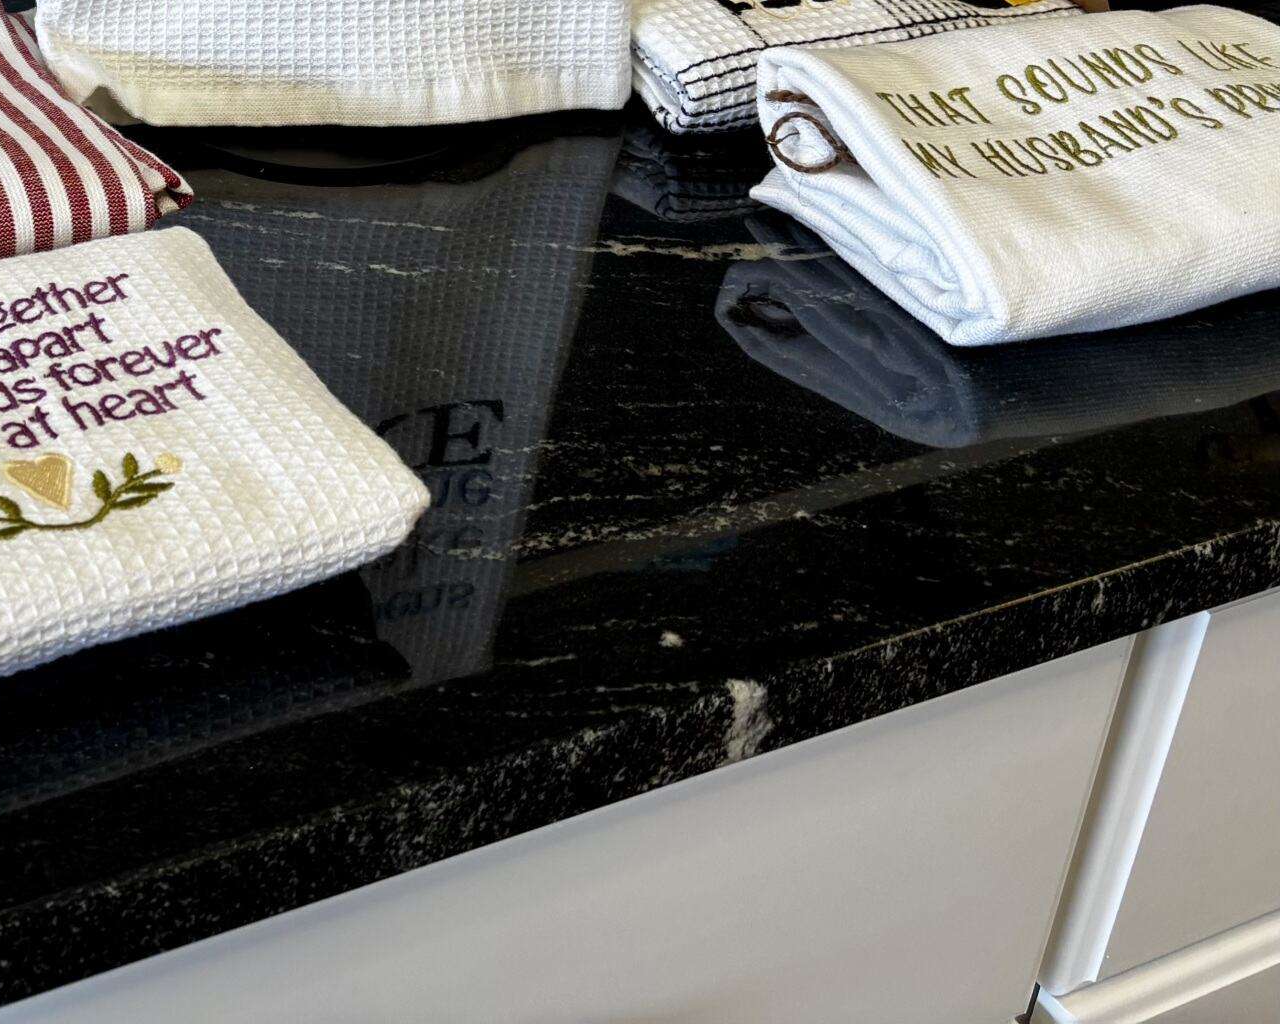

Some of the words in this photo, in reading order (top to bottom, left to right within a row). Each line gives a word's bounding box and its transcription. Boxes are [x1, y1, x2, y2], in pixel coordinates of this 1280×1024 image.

[876, 86, 991, 127] THAT
[996, 43, 1183, 116] SOUNDS
[1176, 39, 1280, 71] LIKE
[901, 138, 978, 179] MY
[970, 95, 1225, 178] HUSBAND'S
[44, 328, 222, 391] forever
[1, 405, 58, 450] at
[61, 370, 206, 430] heart
